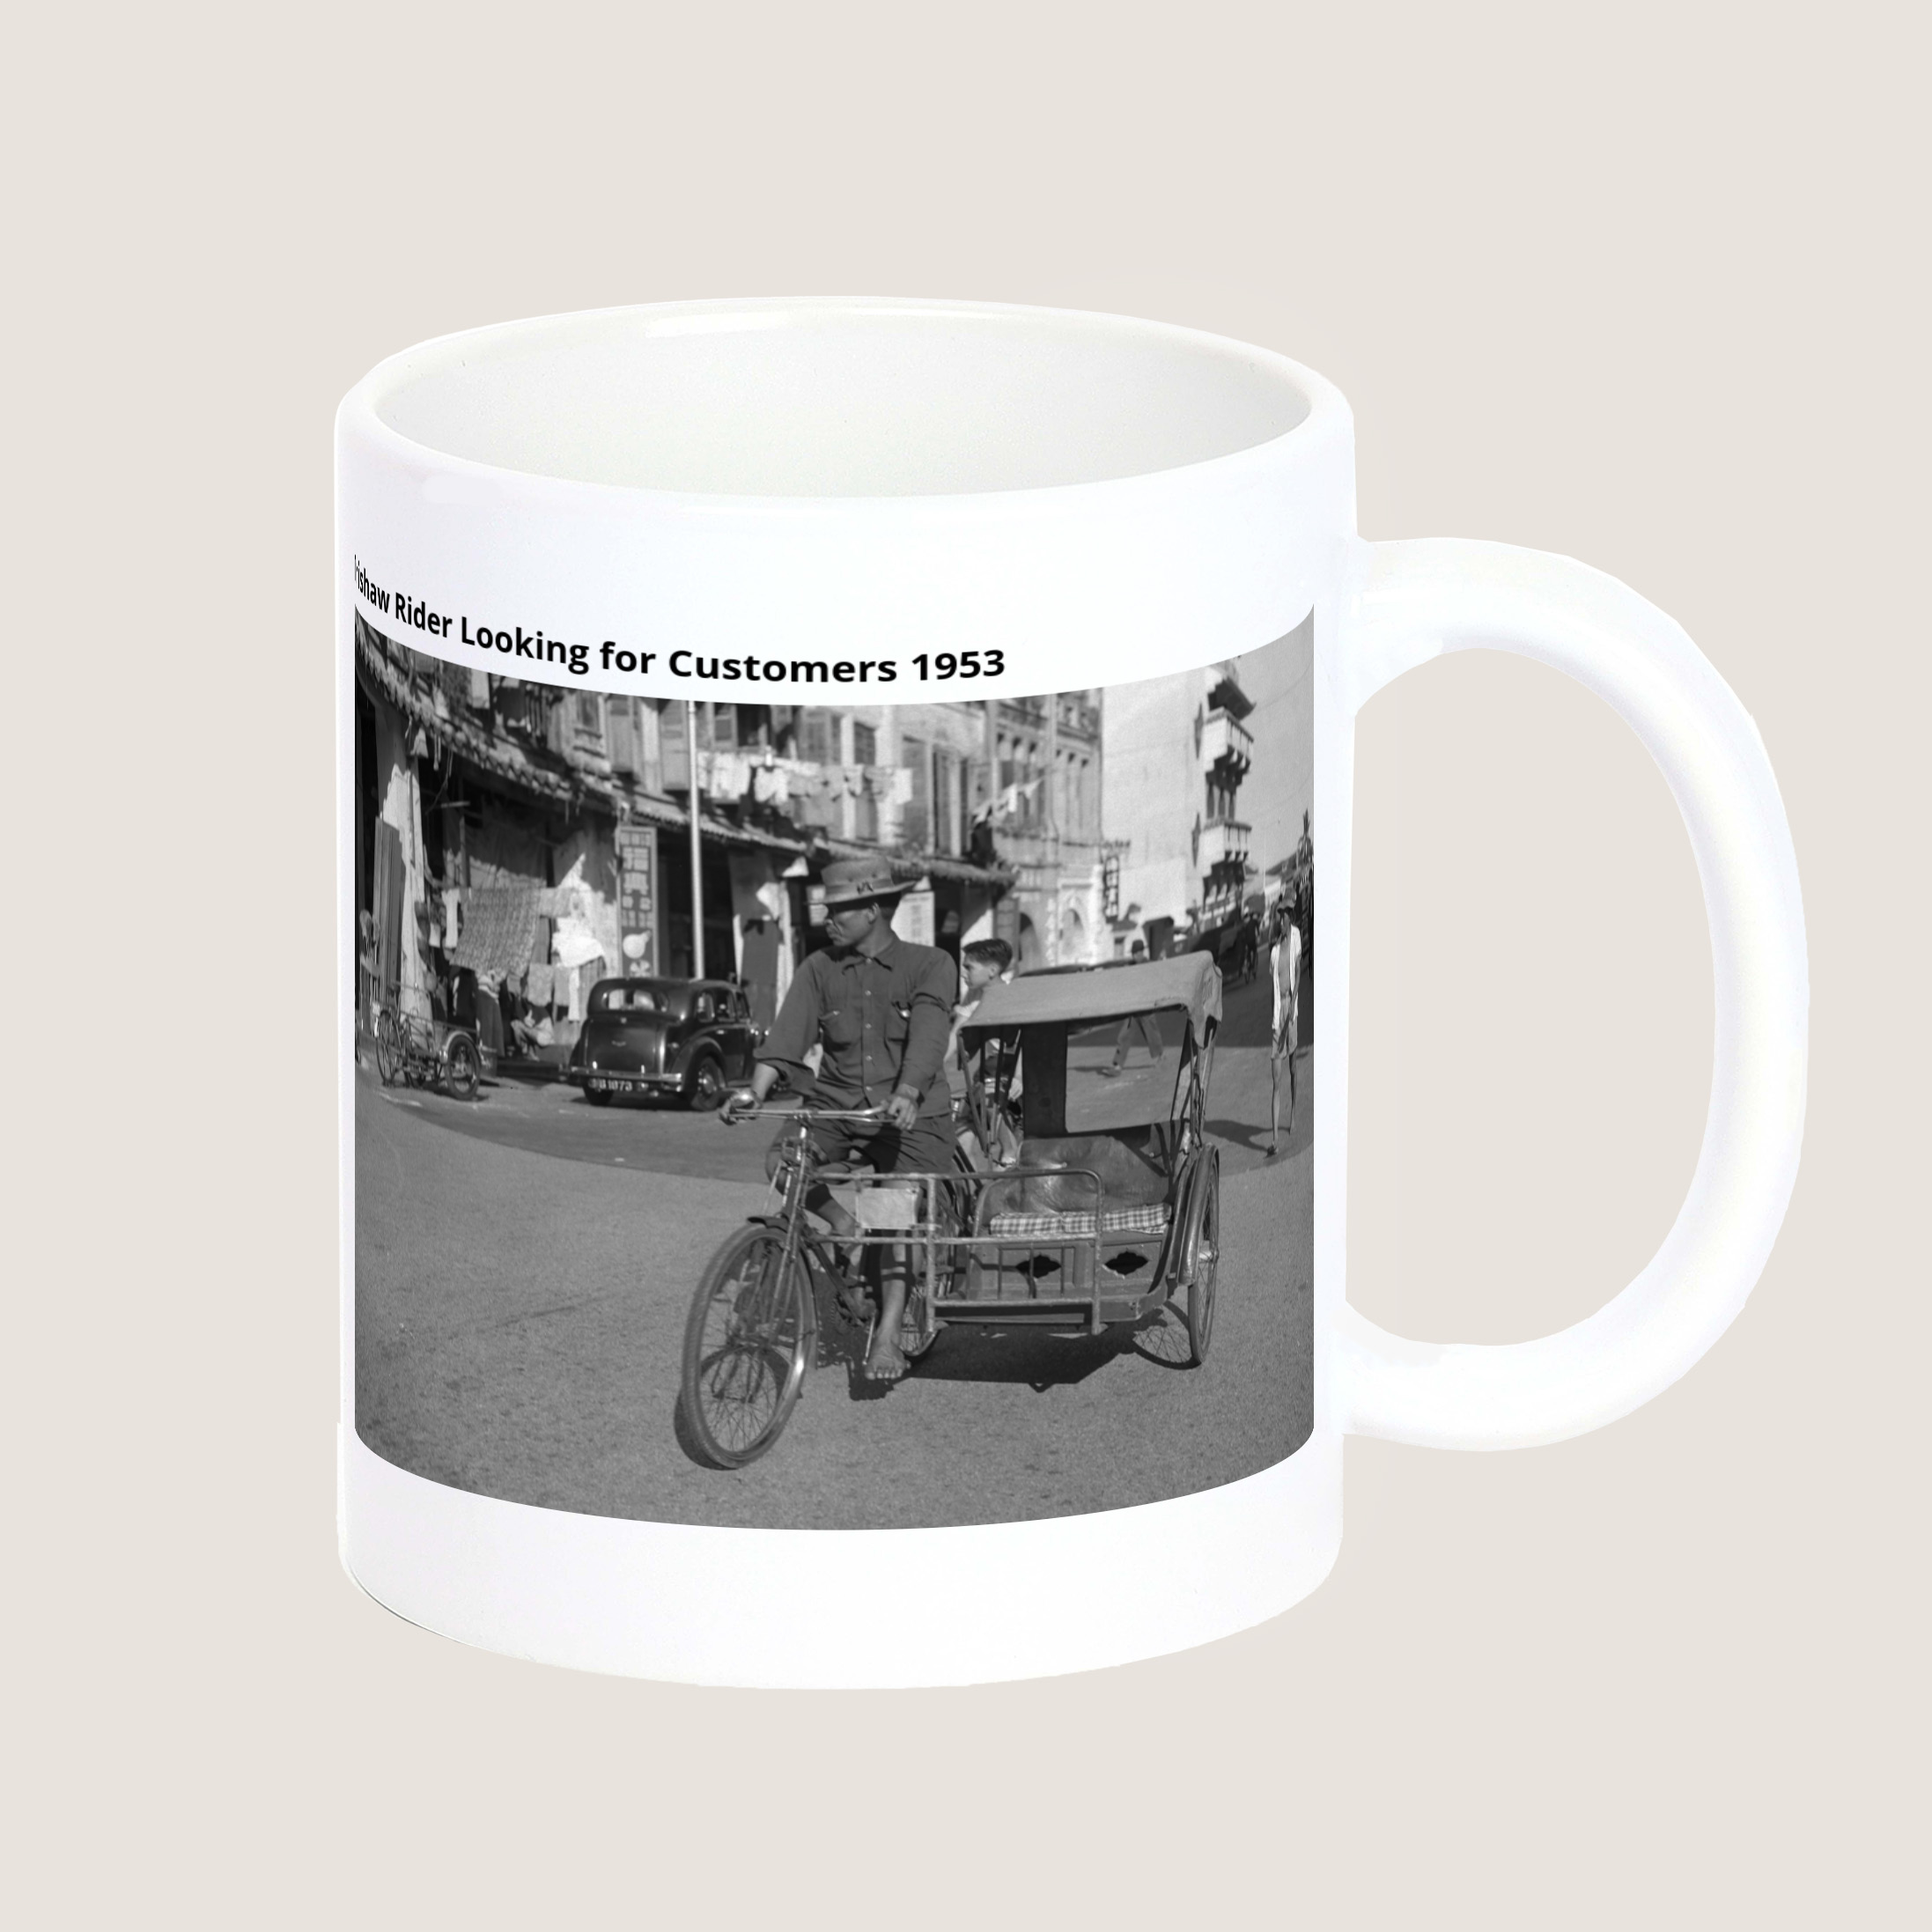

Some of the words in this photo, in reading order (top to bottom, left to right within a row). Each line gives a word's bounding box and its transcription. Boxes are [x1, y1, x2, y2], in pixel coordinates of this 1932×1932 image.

[354, 554, 390, 614] rishaw
[395, 592, 454, 638] Rider
[461, 616, 590, 675] Looking
[600, 640, 657, 675] for
[668, 650, 897, 683] Customers
[911, 649, 1006, 682] 1953
